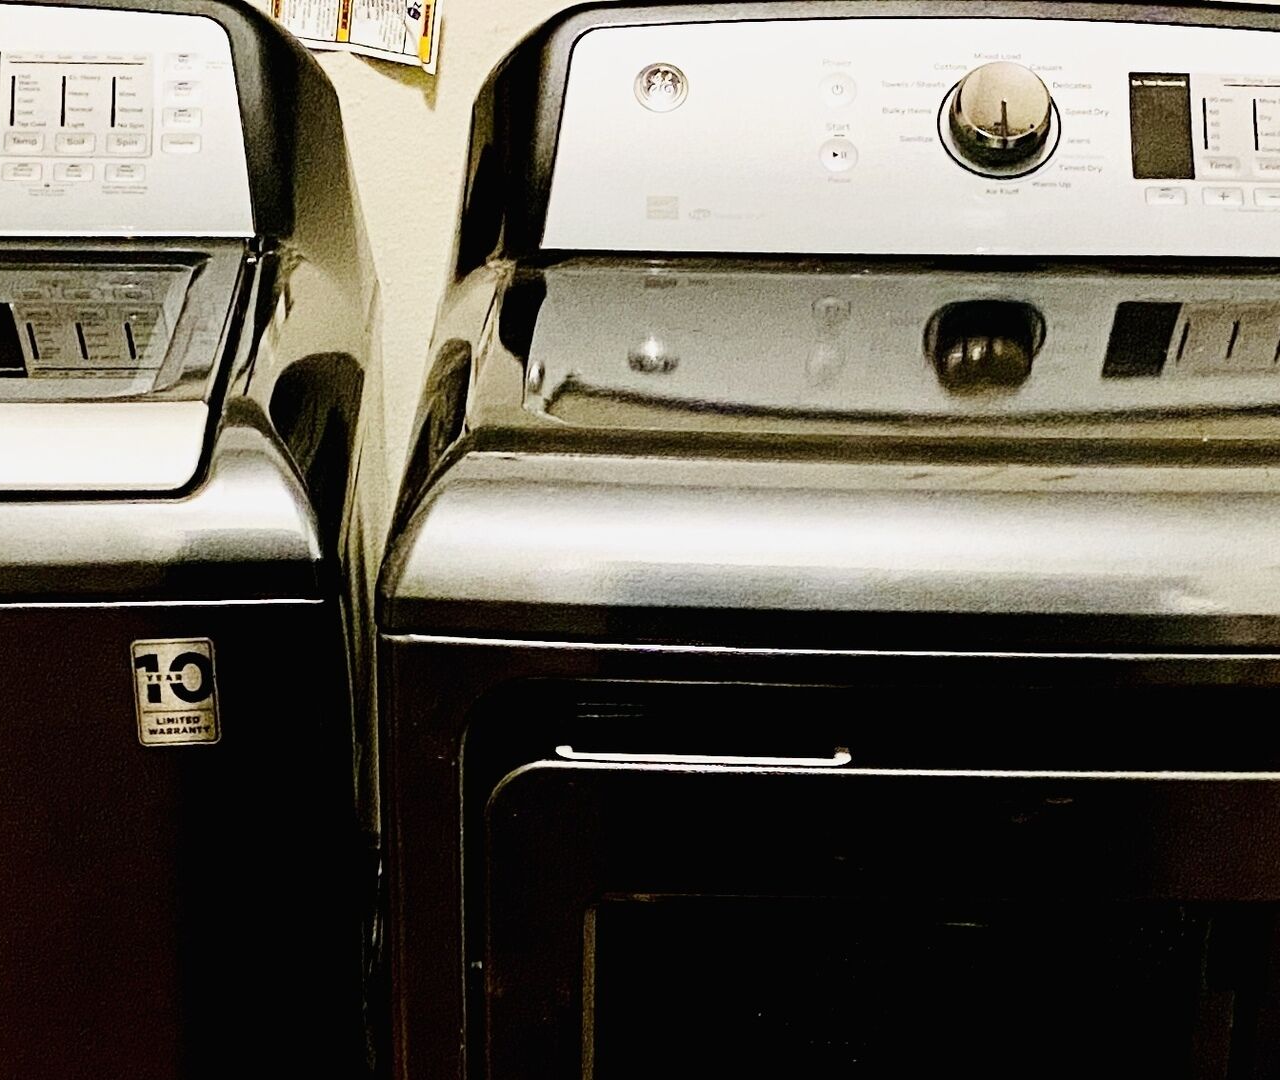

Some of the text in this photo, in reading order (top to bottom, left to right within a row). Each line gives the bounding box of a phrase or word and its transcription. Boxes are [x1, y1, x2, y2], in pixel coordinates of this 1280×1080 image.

[882, 107, 905, 115] Bulky
[1065, 108, 1109, 117] Speed Dry
[826, 123, 851, 132] Start
[12, 137, 38, 147] Temp
[66, 137, 85, 146] Soil
[115, 138, 139, 148] Spin
[899, 135, 933, 143] Sanitize
[1059, 164, 1103, 173] Timed Dry
[1209, 162, 1233, 170] Time
[135, 651, 212, 704] 10
[146, 674, 182, 682] YEAR
[156, 716, 200, 726] LIMITED
[147, 725, 211, 736] WARRANTY
